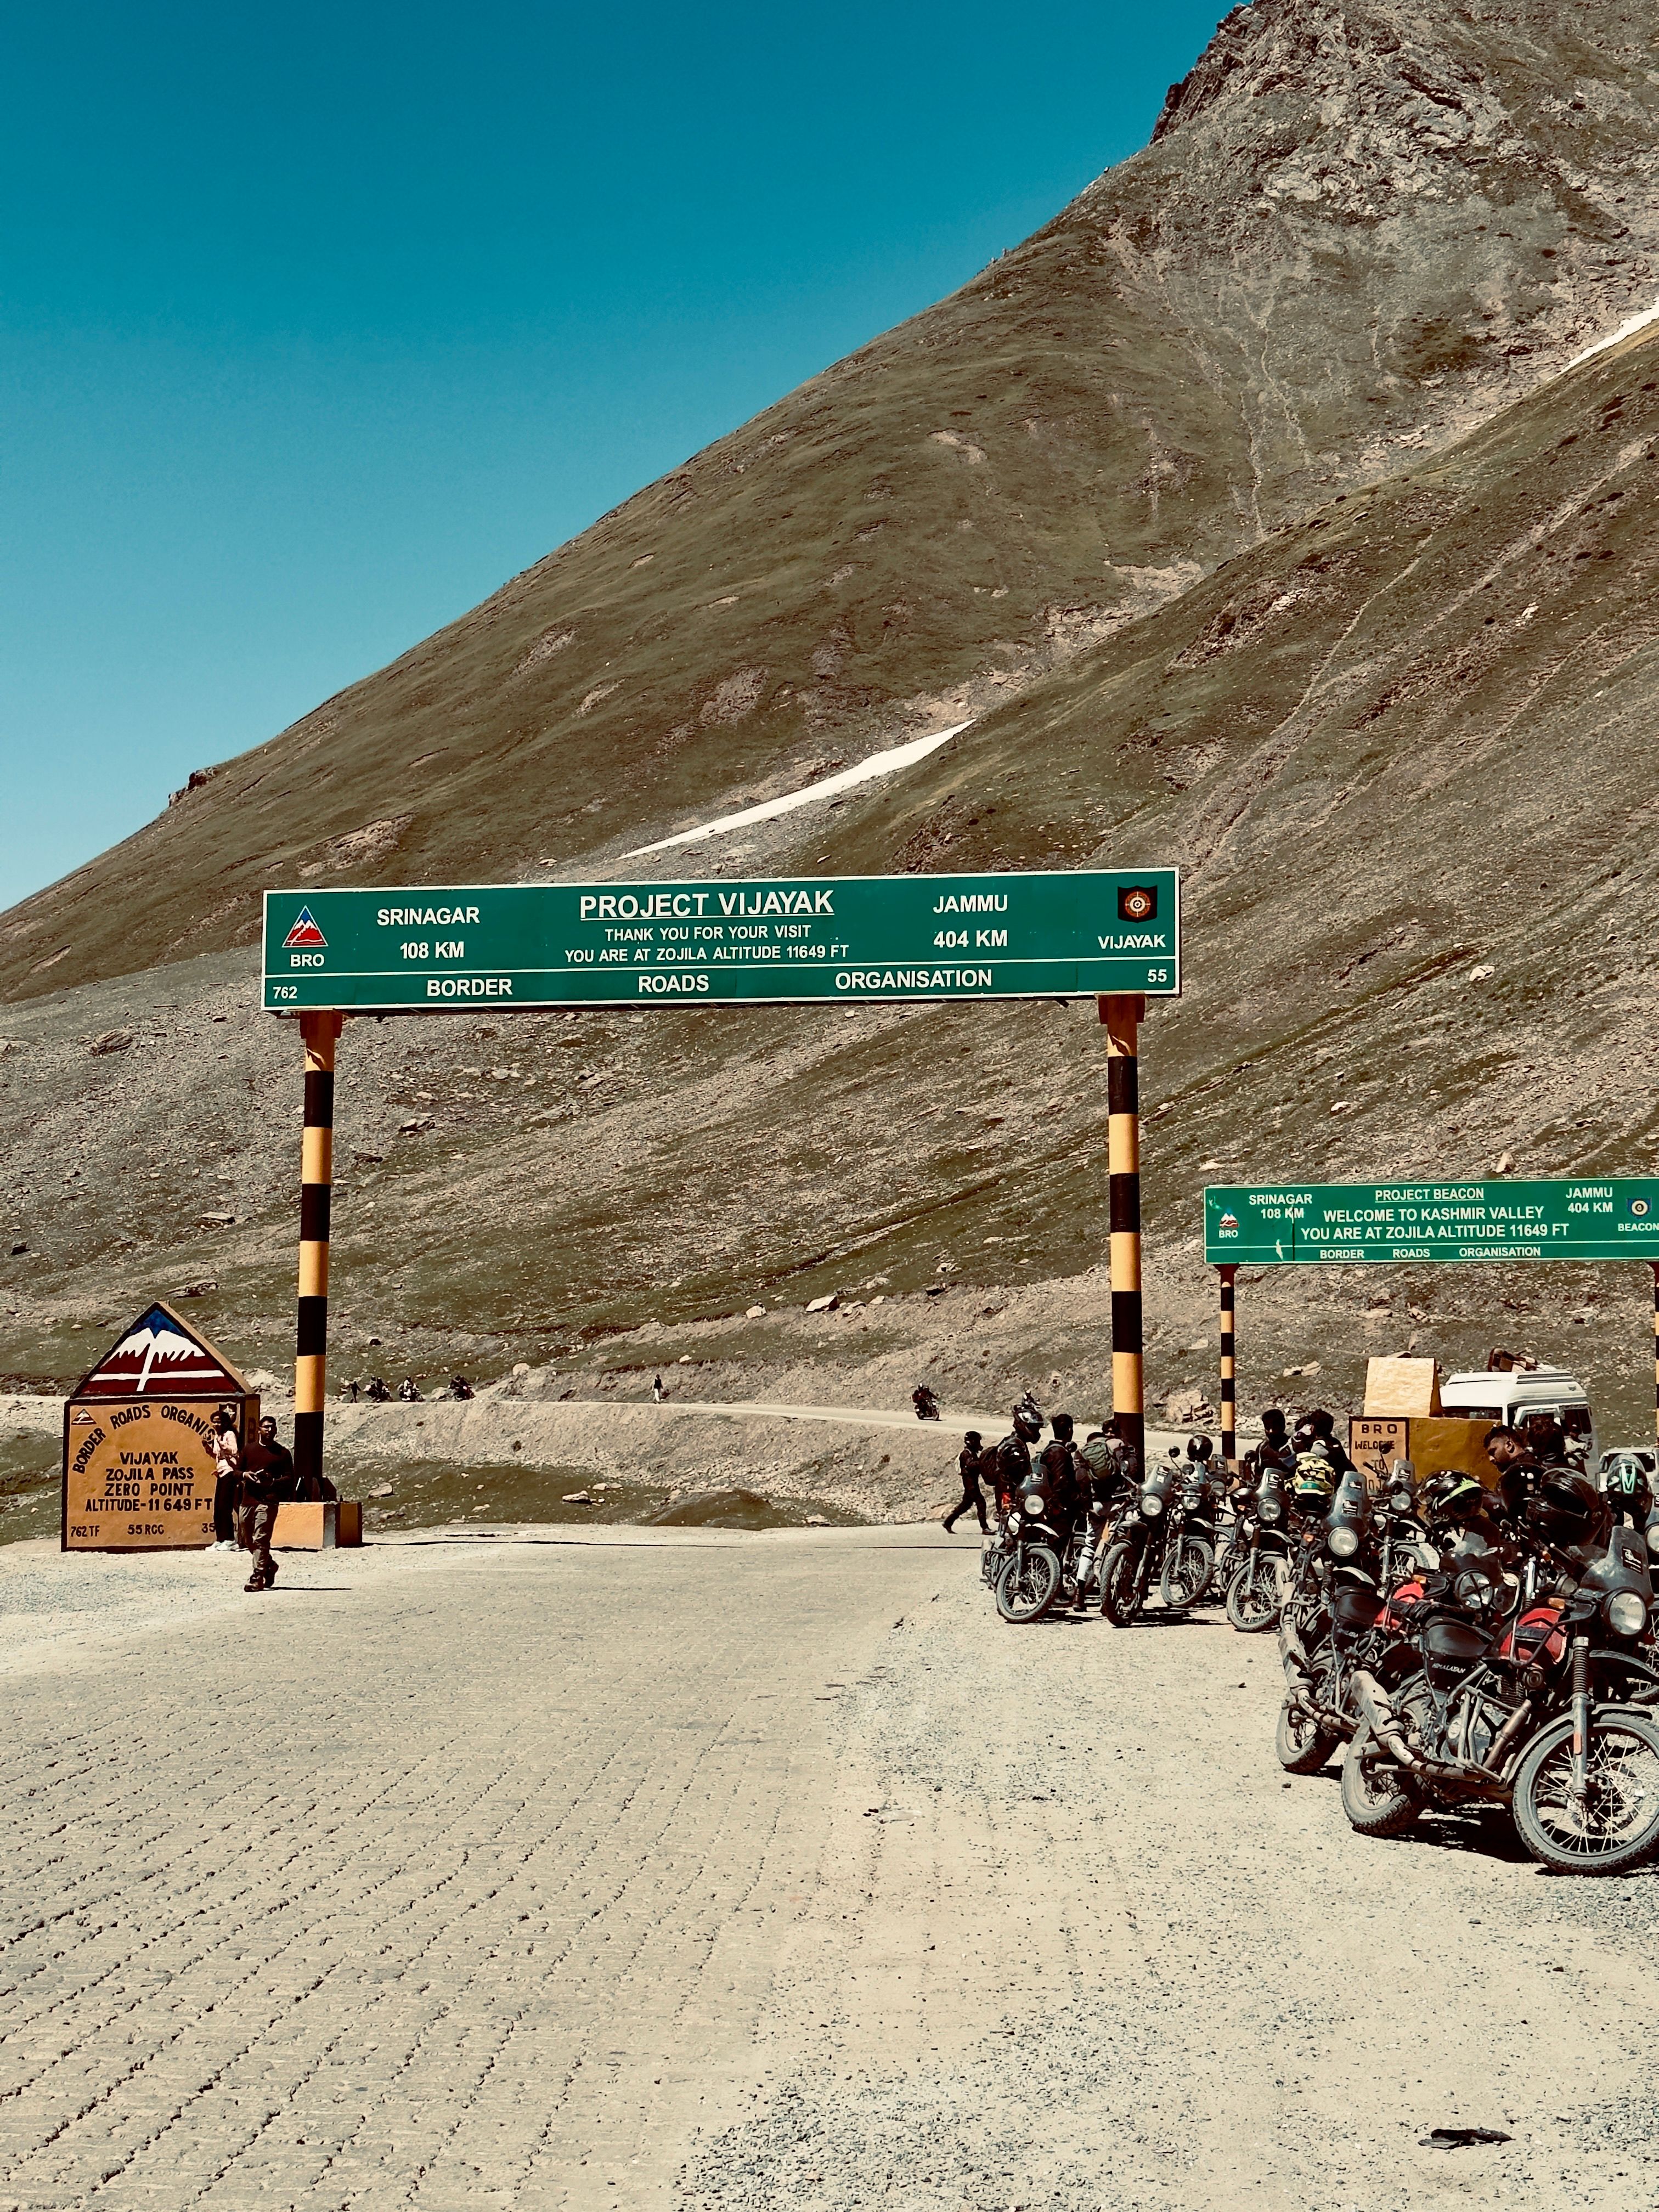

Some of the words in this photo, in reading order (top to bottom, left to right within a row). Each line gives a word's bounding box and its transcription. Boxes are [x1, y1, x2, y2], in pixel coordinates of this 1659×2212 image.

[580, 894, 709, 918] PROJECT
[718, 890, 834, 915] VIJAYAK
[933, 894, 1008, 913] JAMMU
[377, 906, 480, 926] SRINAGAR
[605, 927, 653, 941] THANK
[659, 927, 689, 940] YOU
[694, 926, 724, 940] FOR
[728, 925, 769, 939] YOUR
[774, 924, 811, 938] VISIT
[933, 930, 969, 948] 404
[976, 929, 1007, 947] KM
[1097, 934, 1166, 949] VIJAYAK
[400, 942, 429, 959] 108
[435, 941, 464, 958] KM
[565, 949, 594, 963] YOU
[599, 949, 628, 962] ARE
[633, 948, 651, 961] AT
[656, 947, 707, 961] ZOJILA
[713, 945, 781, 960] ALTITUDE
[786, 945, 826, 958] 11649
[831, 944, 849, 958] FT
[290, 953, 325, 967] BRO
[427, 978, 513, 997] BORDER
[639, 974, 709, 993] ROADS
[835, 969, 992, 990] ORGANISATION
[1147, 969, 1167, 983] 55
[273, 986, 297, 999] 762
[1249, 1193, 1312, 1205] SRINAGAR
[1375, 1188, 1431, 1201] PROJECT
[1434, 1187, 1484, 1199] BEACON
[1565, 1187, 1613, 1199] JAMMU
[1261, 1208, 1281, 1219] 108
[1284, 1207, 1304, 1219] KM
[1323, 1209, 1395, 1222] WELCOME
[1398, 1208, 1418, 1221] TO
[1421, 1207, 1486, 1221] KASHMIR
[1489, 1206, 1544, 1220] VALLEY
[1567, 1202, 1589, 1213] 404
[1593, 1201, 1613, 1212] KM
[1218, 1229, 1238, 1238] BRO
[1301, 1227, 1330, 1240] YOU
[1333, 1227, 1362, 1239] ARE
[1364, 1227, 1383, 1239] AT
[1385, 1226, 1435, 1239] ZOJILA
[1437, 1224, 1506, 1238] ALTITUDE
[1510, 1223, 1548, 1237] 11649
[1552, 1223, 1570, 1236] FT
[1618, 1222, 1659, 1232] BEACON
[1320, 1249, 1364, 1259] BORDER
[1392, 1248, 1430, 1259] ROADS
[1459, 1246, 1541, 1257] ORGANISATION
[72, 1427, 106, 1474] BORDER
[110, 1404, 151, 1430] ROADS
[120, 1451, 178, 1465] VIJAYAK
[106, 1468, 155, 1481] ZOJILA
[162, 1467, 194, 1480] PASS
[104, 1482, 140, 1497] ZERO
[150, 1482, 194, 1496] POINT
[195, 1498, 213, 1510] FT
